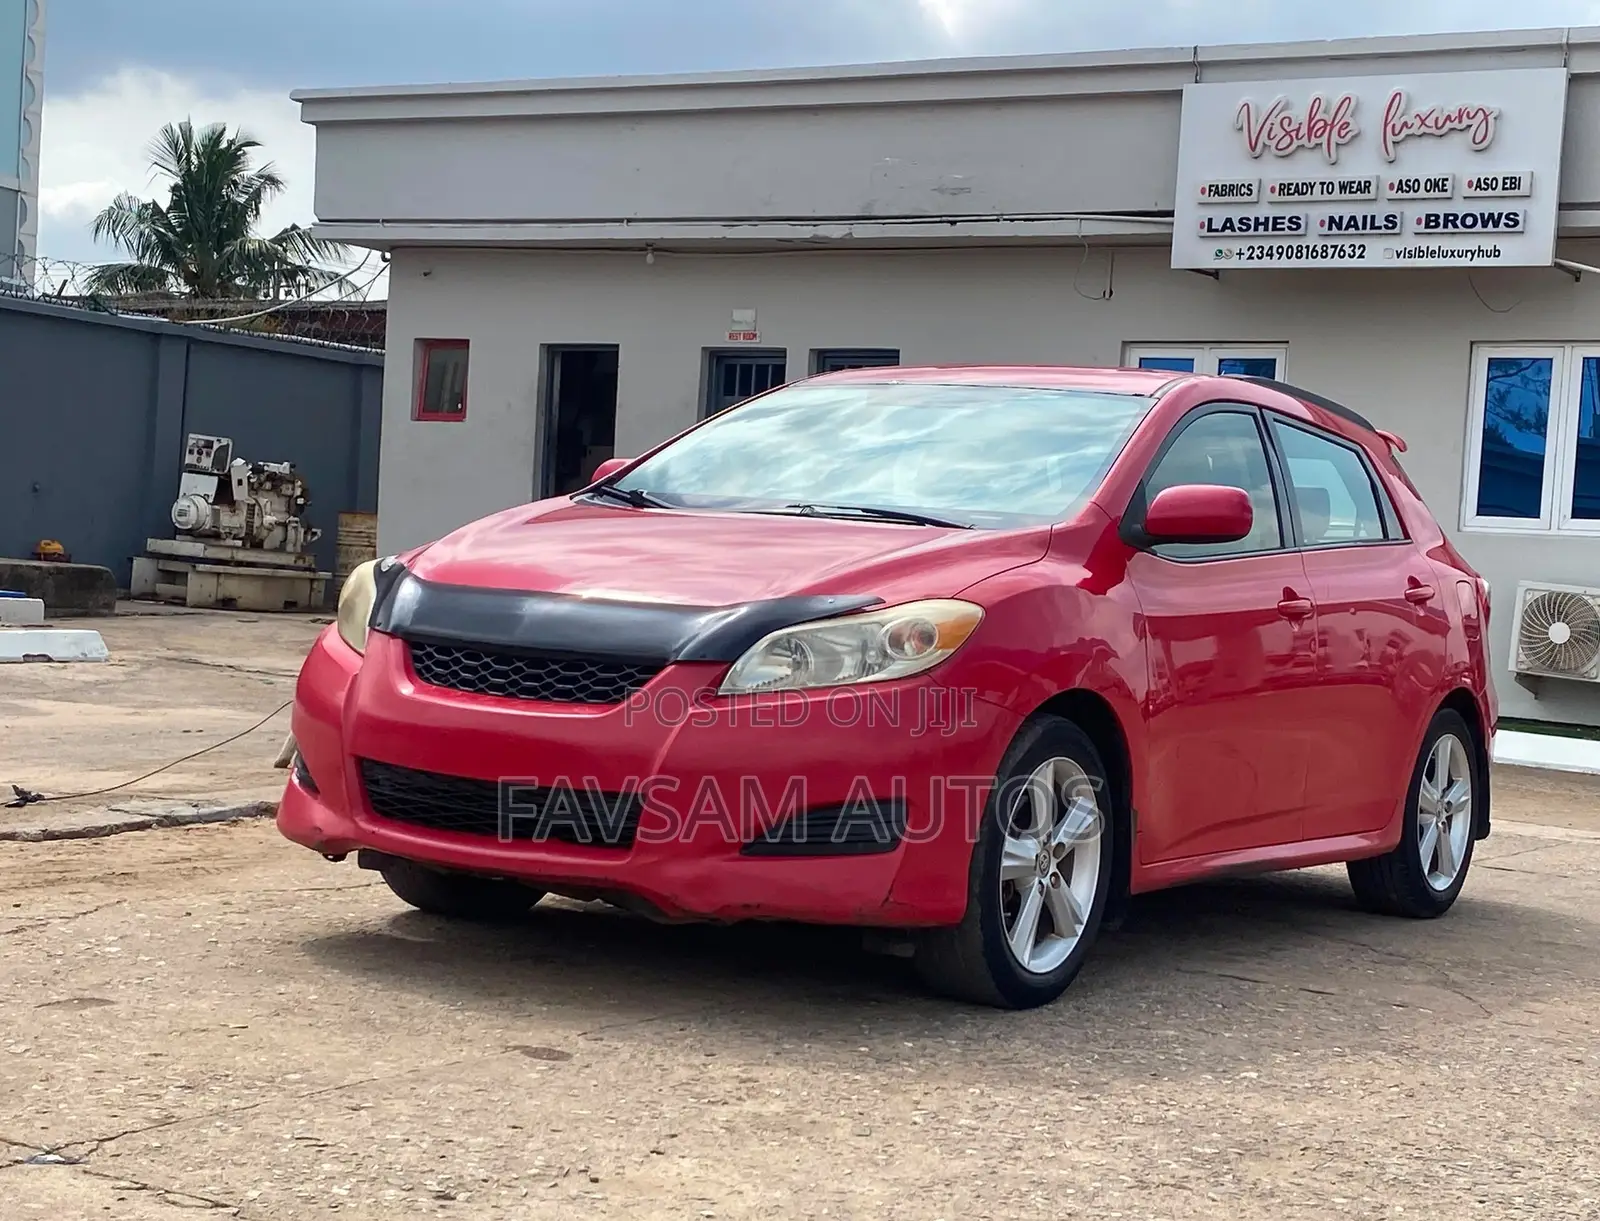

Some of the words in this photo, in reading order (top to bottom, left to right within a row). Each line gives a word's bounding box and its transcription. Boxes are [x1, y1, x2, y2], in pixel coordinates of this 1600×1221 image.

[1236, 96, 1352, 158] Visible
[1207, 183, 1254, 198] FABRICS
[1278, 181, 1316, 197] READY
[1319, 181, 1335, 196] TO
[1338, 179, 1372, 195] WEAR
[1396, 178, 1421, 194] ASO
[1424, 177, 1449, 193] OKE
[1474, 176, 1499, 192] ASO
[1501, 176, 1522, 191] EBI
[1206, 215, 1302, 233] LASHES
[1327, 214, 1398, 231] NAILS
[1424, 211, 1520, 230] BROWS
[1236, 244, 1367, 260] +2349081687632
[1395, 244, 1501, 262] visibleluxuryhub
